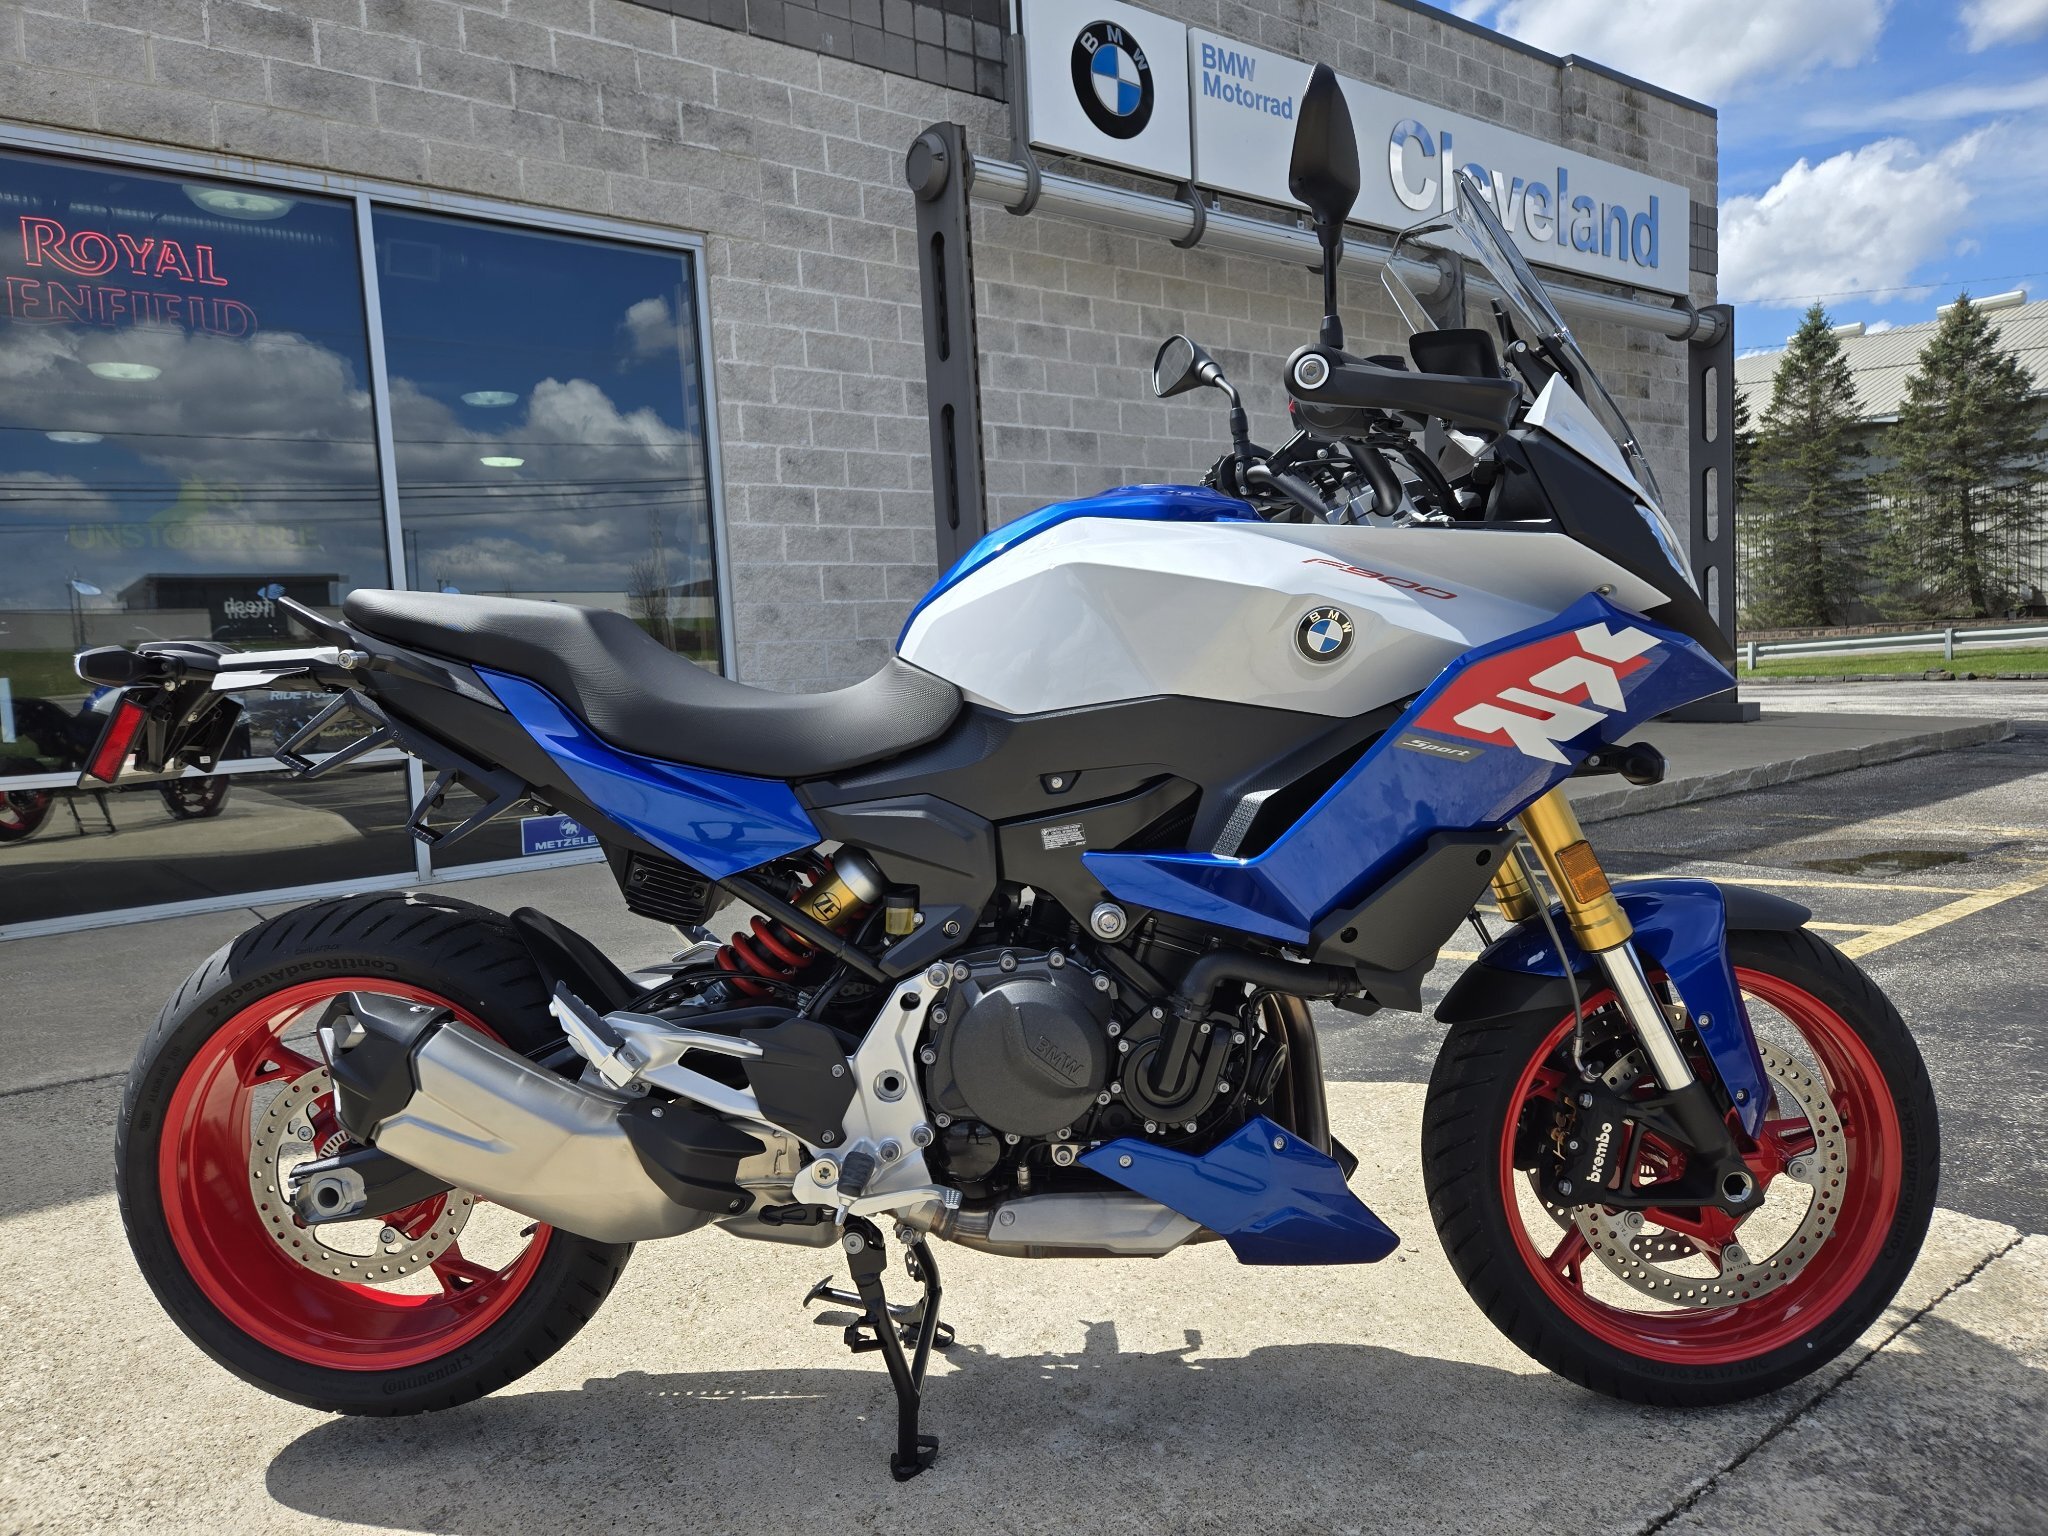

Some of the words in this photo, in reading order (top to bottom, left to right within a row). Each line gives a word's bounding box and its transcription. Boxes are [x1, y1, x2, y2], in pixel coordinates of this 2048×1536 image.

[1080, 24, 1149, 72] BMW
[1201, 42, 1256, 82] BMW
[1202, 71, 1293, 120] Motorrad
[1388, 118, 1660, 269] Cleveland
[19, 215, 229, 287] ROYAL
[6, 275, 258, 338] ENFIELD
[1309, 609, 1352, 633] BMW
[1402, 738, 1471, 758] Sport
[535, 835, 599, 851] METZELE
[1035, 1034, 1084, 1077] BMW
[1585, 1122, 1613, 1183] brembo
